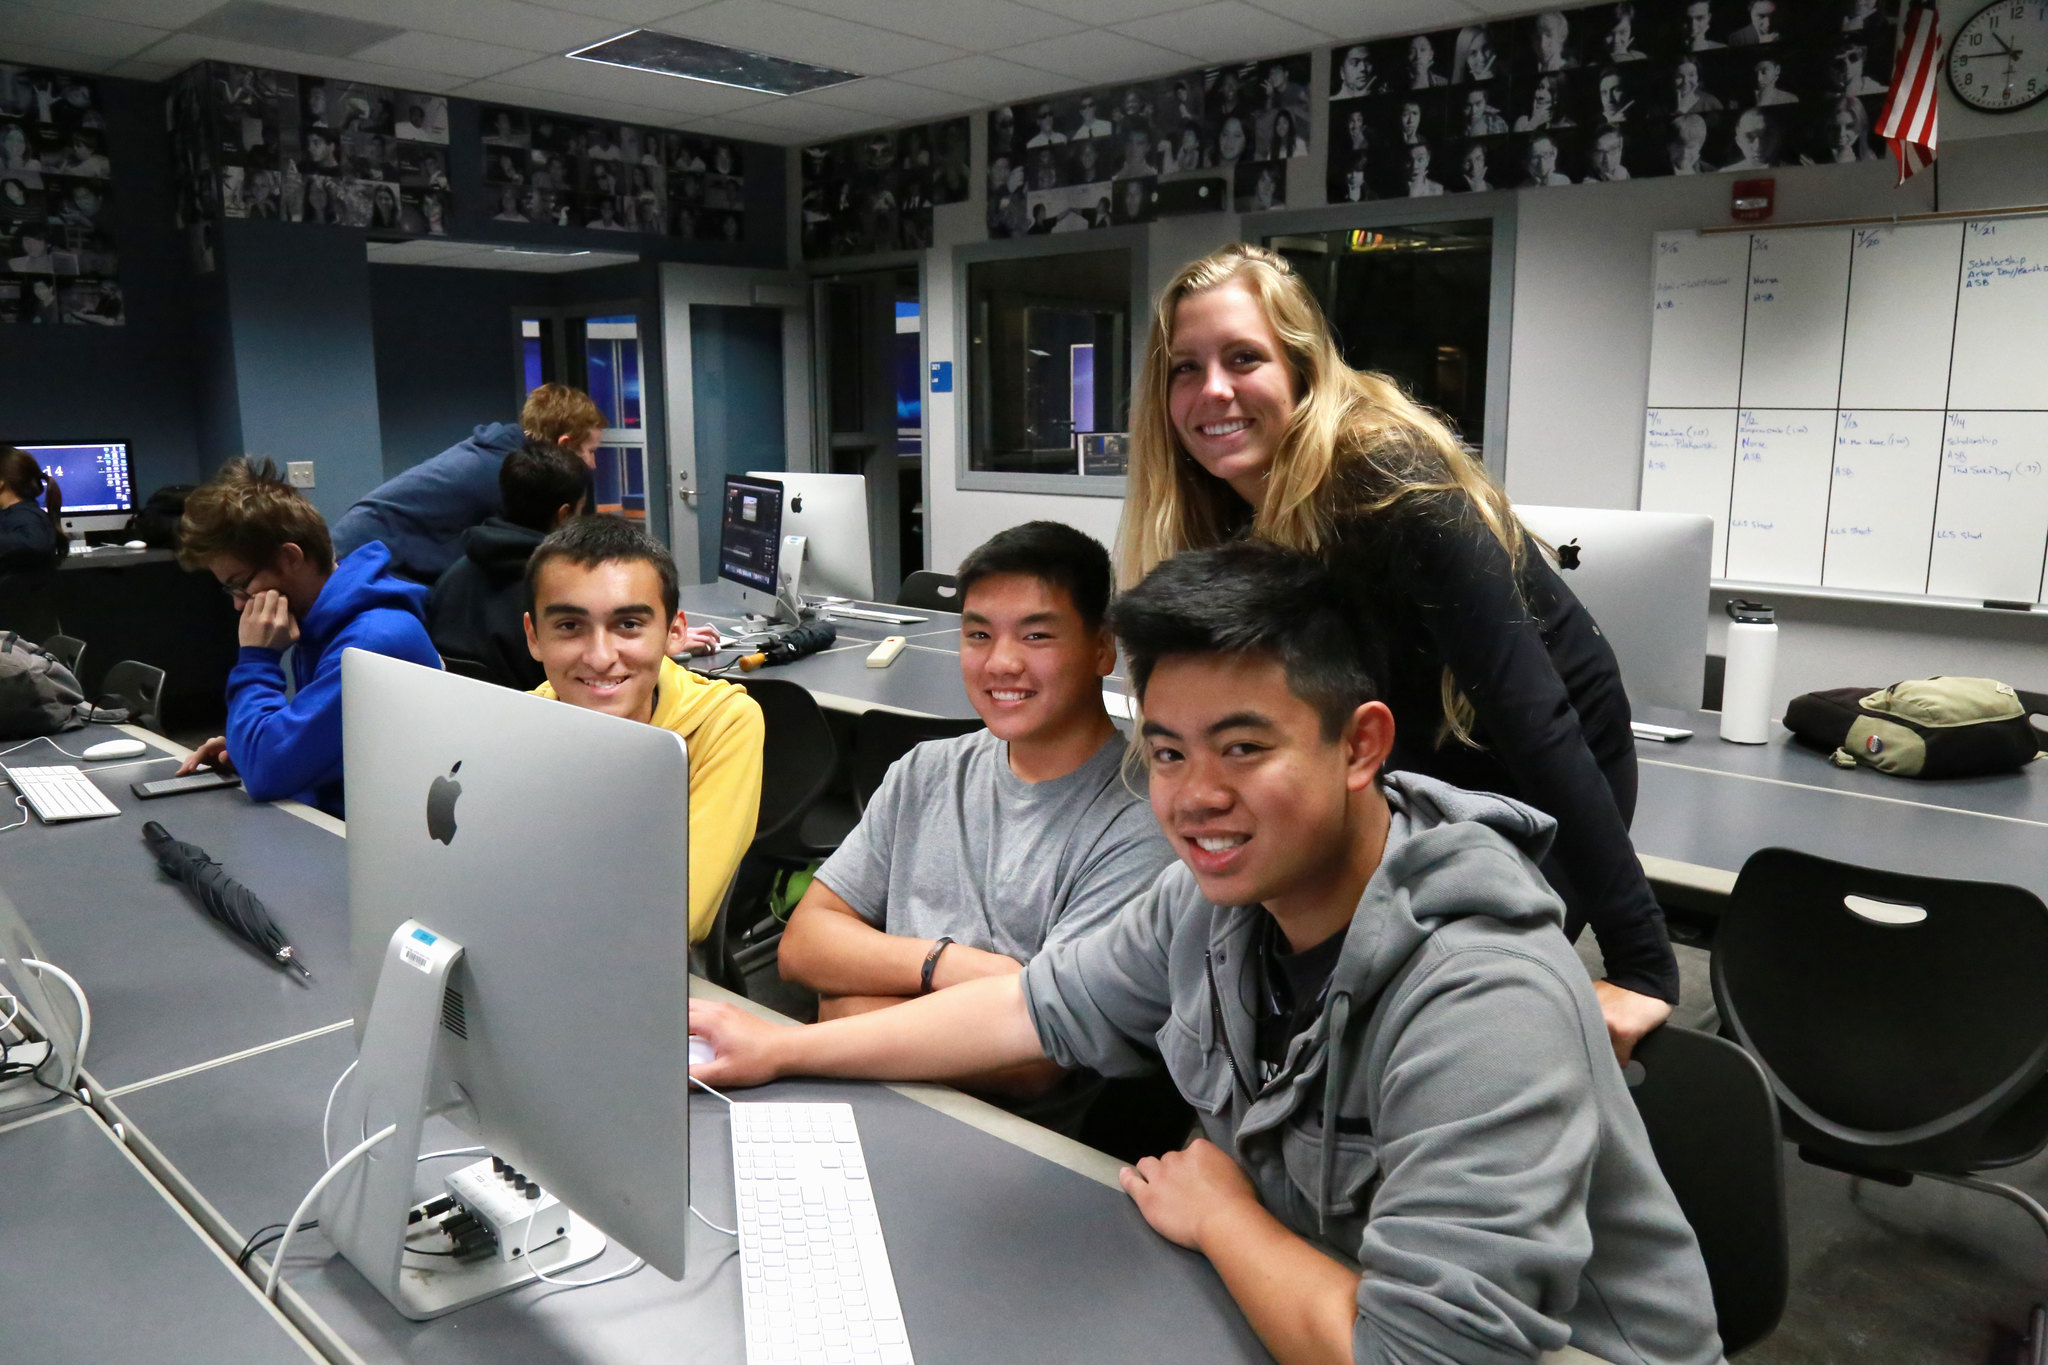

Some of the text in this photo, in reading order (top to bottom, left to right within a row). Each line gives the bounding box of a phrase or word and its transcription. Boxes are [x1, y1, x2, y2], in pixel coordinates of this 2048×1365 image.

[2010, 6, 2024, 19] 12
[2040, 8, 2044, 20] 1
[1989, 16, 1999, 29] 11
[1969, 33, 1983, 46] 10
[1959, 55, 1969, 67] 9
[1964, 73, 1973, 85] 8
[1981, 85, 1989, 97] 7
[2027, 79, 2036, 92] 5
[2002, 89, 2010, 100] 6
[1948, 413, 1966, 429] 4/14
